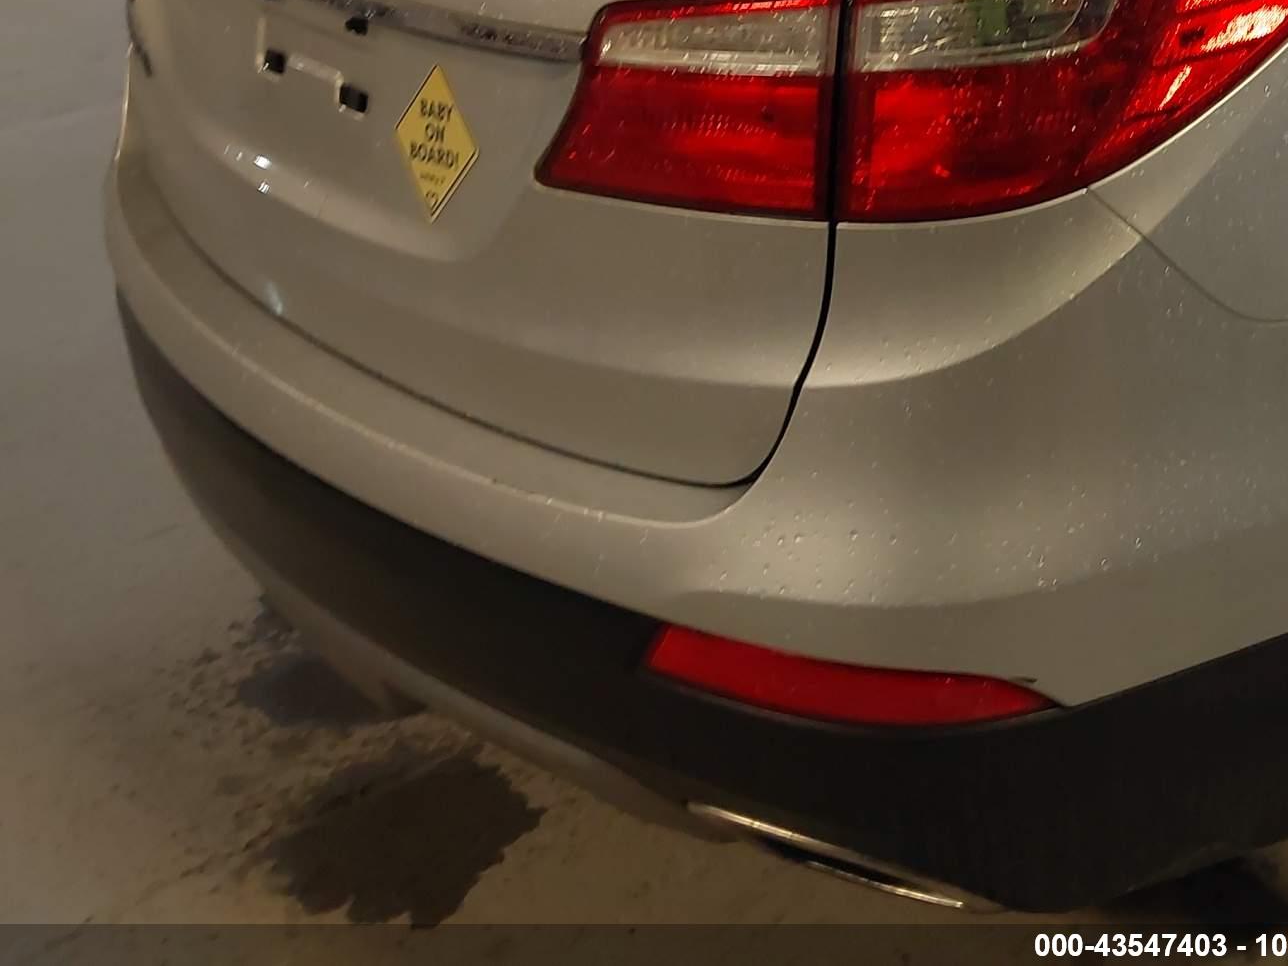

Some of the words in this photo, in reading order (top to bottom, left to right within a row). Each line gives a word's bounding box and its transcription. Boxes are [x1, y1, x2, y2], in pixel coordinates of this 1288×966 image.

[419, 98, 455, 121] BABY
[424, 123, 445, 143] ON
[409, 142, 459, 171] BOARD!
